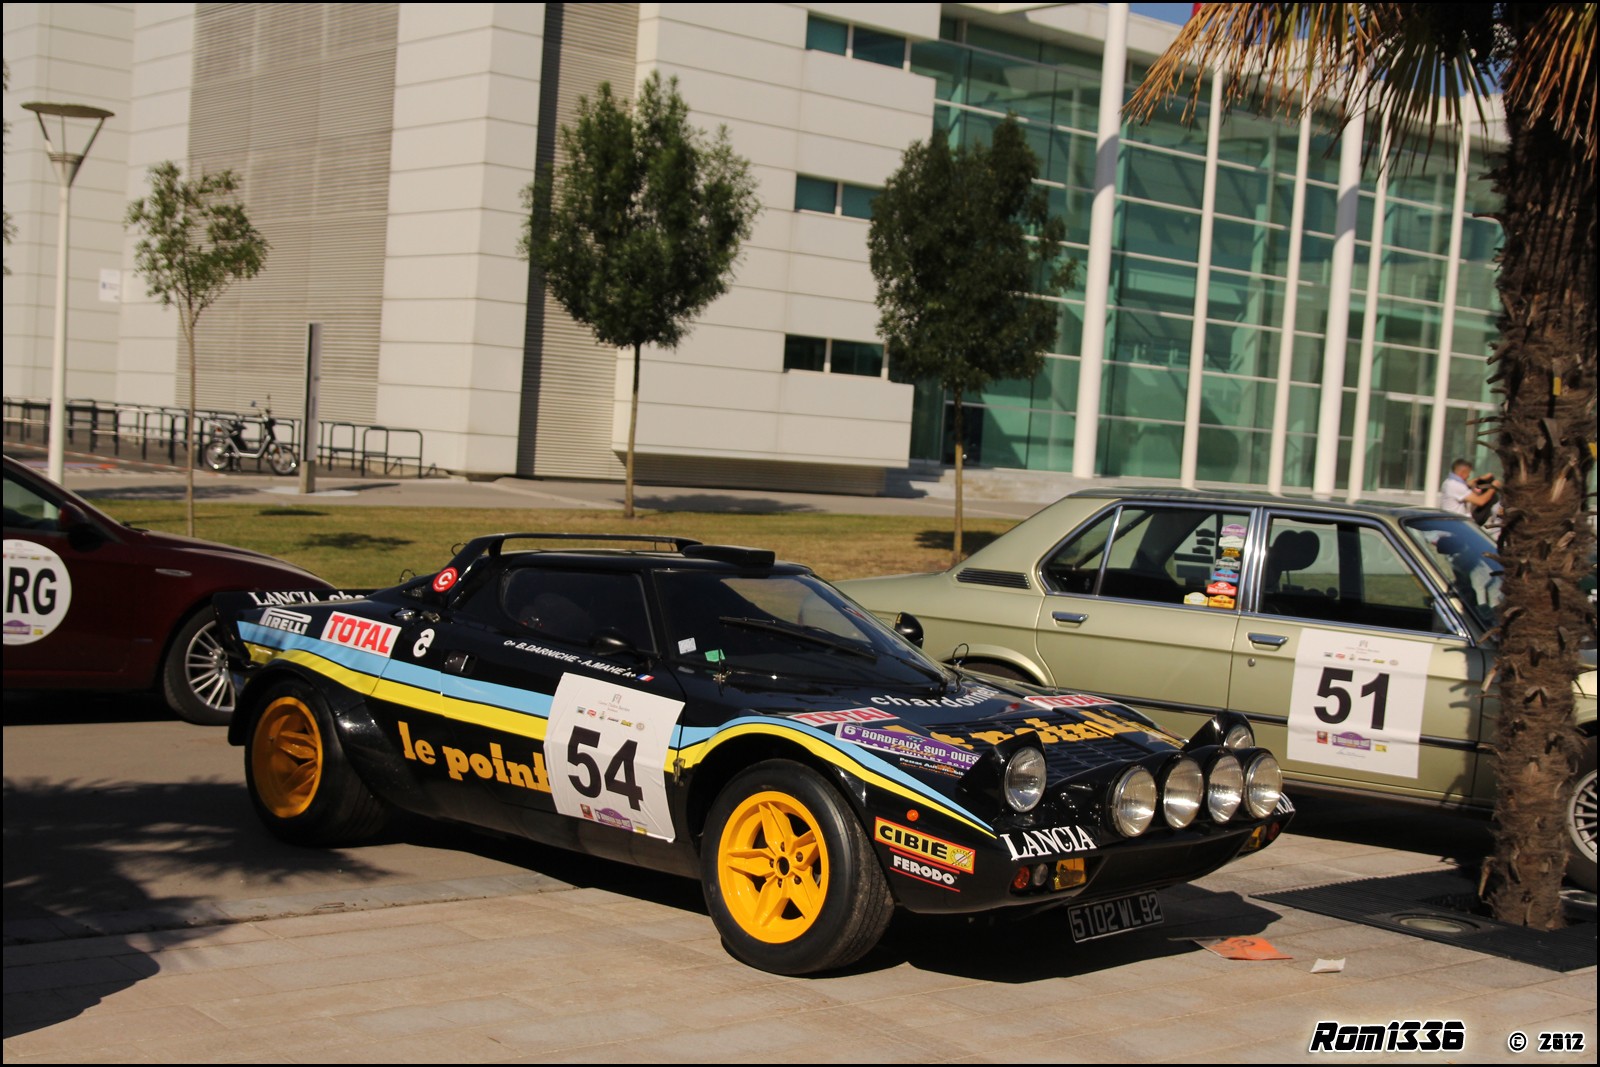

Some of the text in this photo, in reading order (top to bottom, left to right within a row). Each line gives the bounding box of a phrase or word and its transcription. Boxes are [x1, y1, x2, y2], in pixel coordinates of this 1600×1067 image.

[5, 566, 57, 616] RG
[248, 591, 320, 606] LANCIA
[259, 607, 313, 635] PIRELLI
[327, 614, 394, 654] TOTAL
[794, 706, 898, 725] TOTAL
[1314, 666, 1390, 731] 51
[398, 720, 437, 765] le
[861, 729, 922, 751] BORDEAUX
[567, 725, 644, 811] 54
[1000, 825, 1098, 861] LANCIA
[893, 854, 955, 885] FERODO
[1070, 893, 1162, 938] 5102 WL 92
